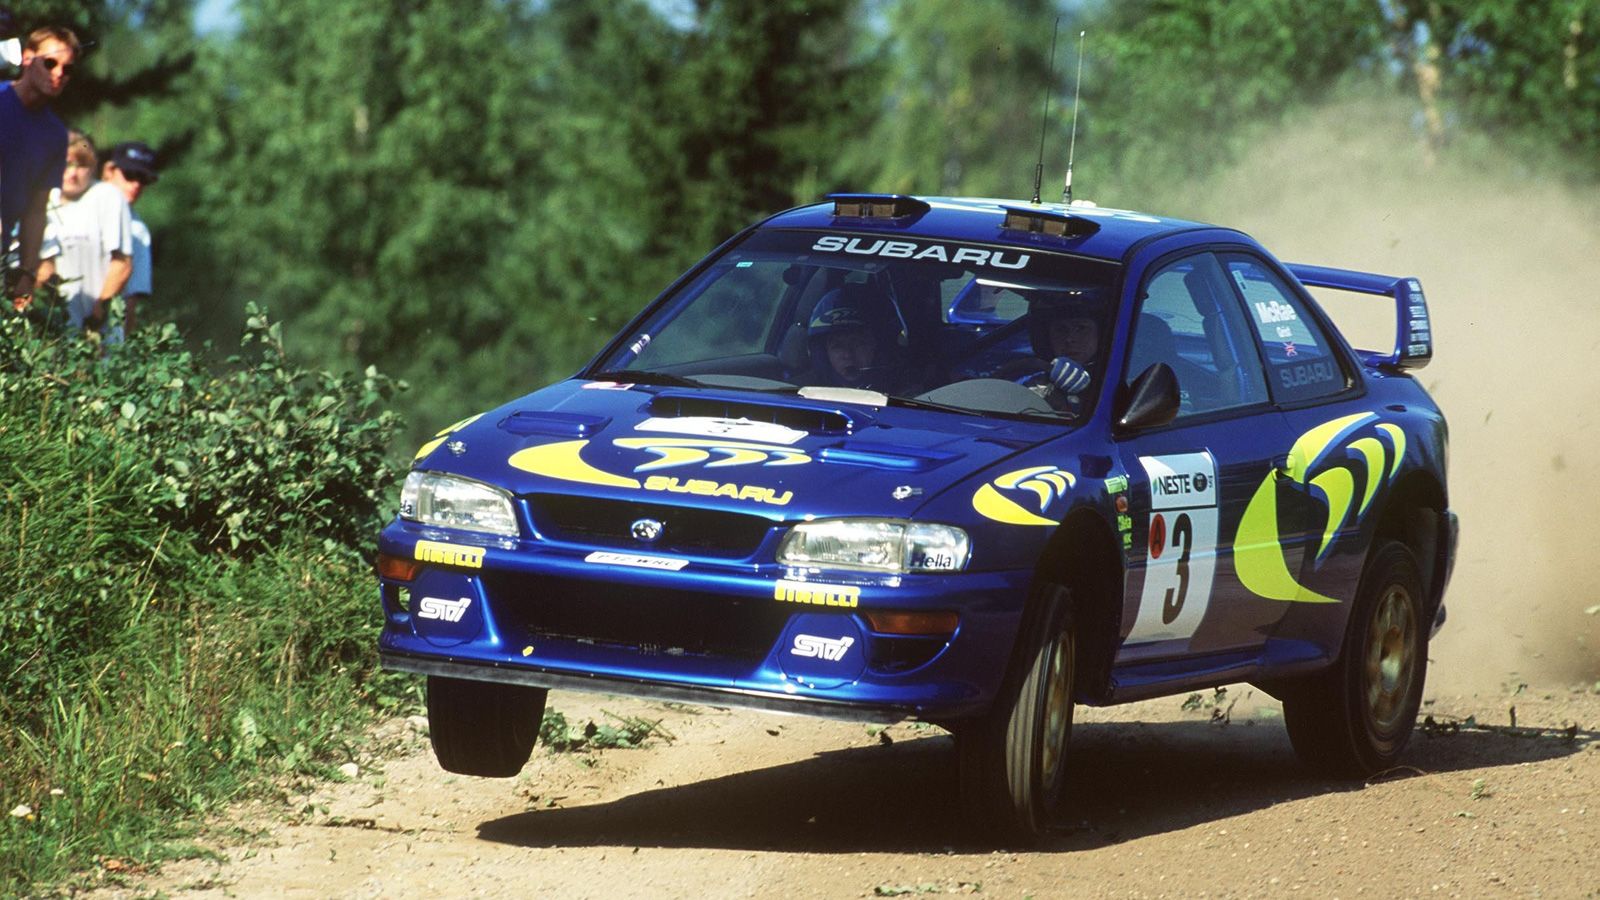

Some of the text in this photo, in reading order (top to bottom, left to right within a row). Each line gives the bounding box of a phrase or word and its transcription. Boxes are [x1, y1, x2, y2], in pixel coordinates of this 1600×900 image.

[812, 236, 1031, 270] SUBARU
[1255, 300, 1297, 324] McRae
[1280, 361, 1334, 388] SUBARU
[644, 475, 793, 506] SUBARU
[1158, 474, 1191, 495] NESTE
[414, 539, 487, 569] PIRELLI
[910, 552, 952, 568] Hella
[1162, 512, 1193, 625] 3
[774, 579, 862, 608] PIRELLI
